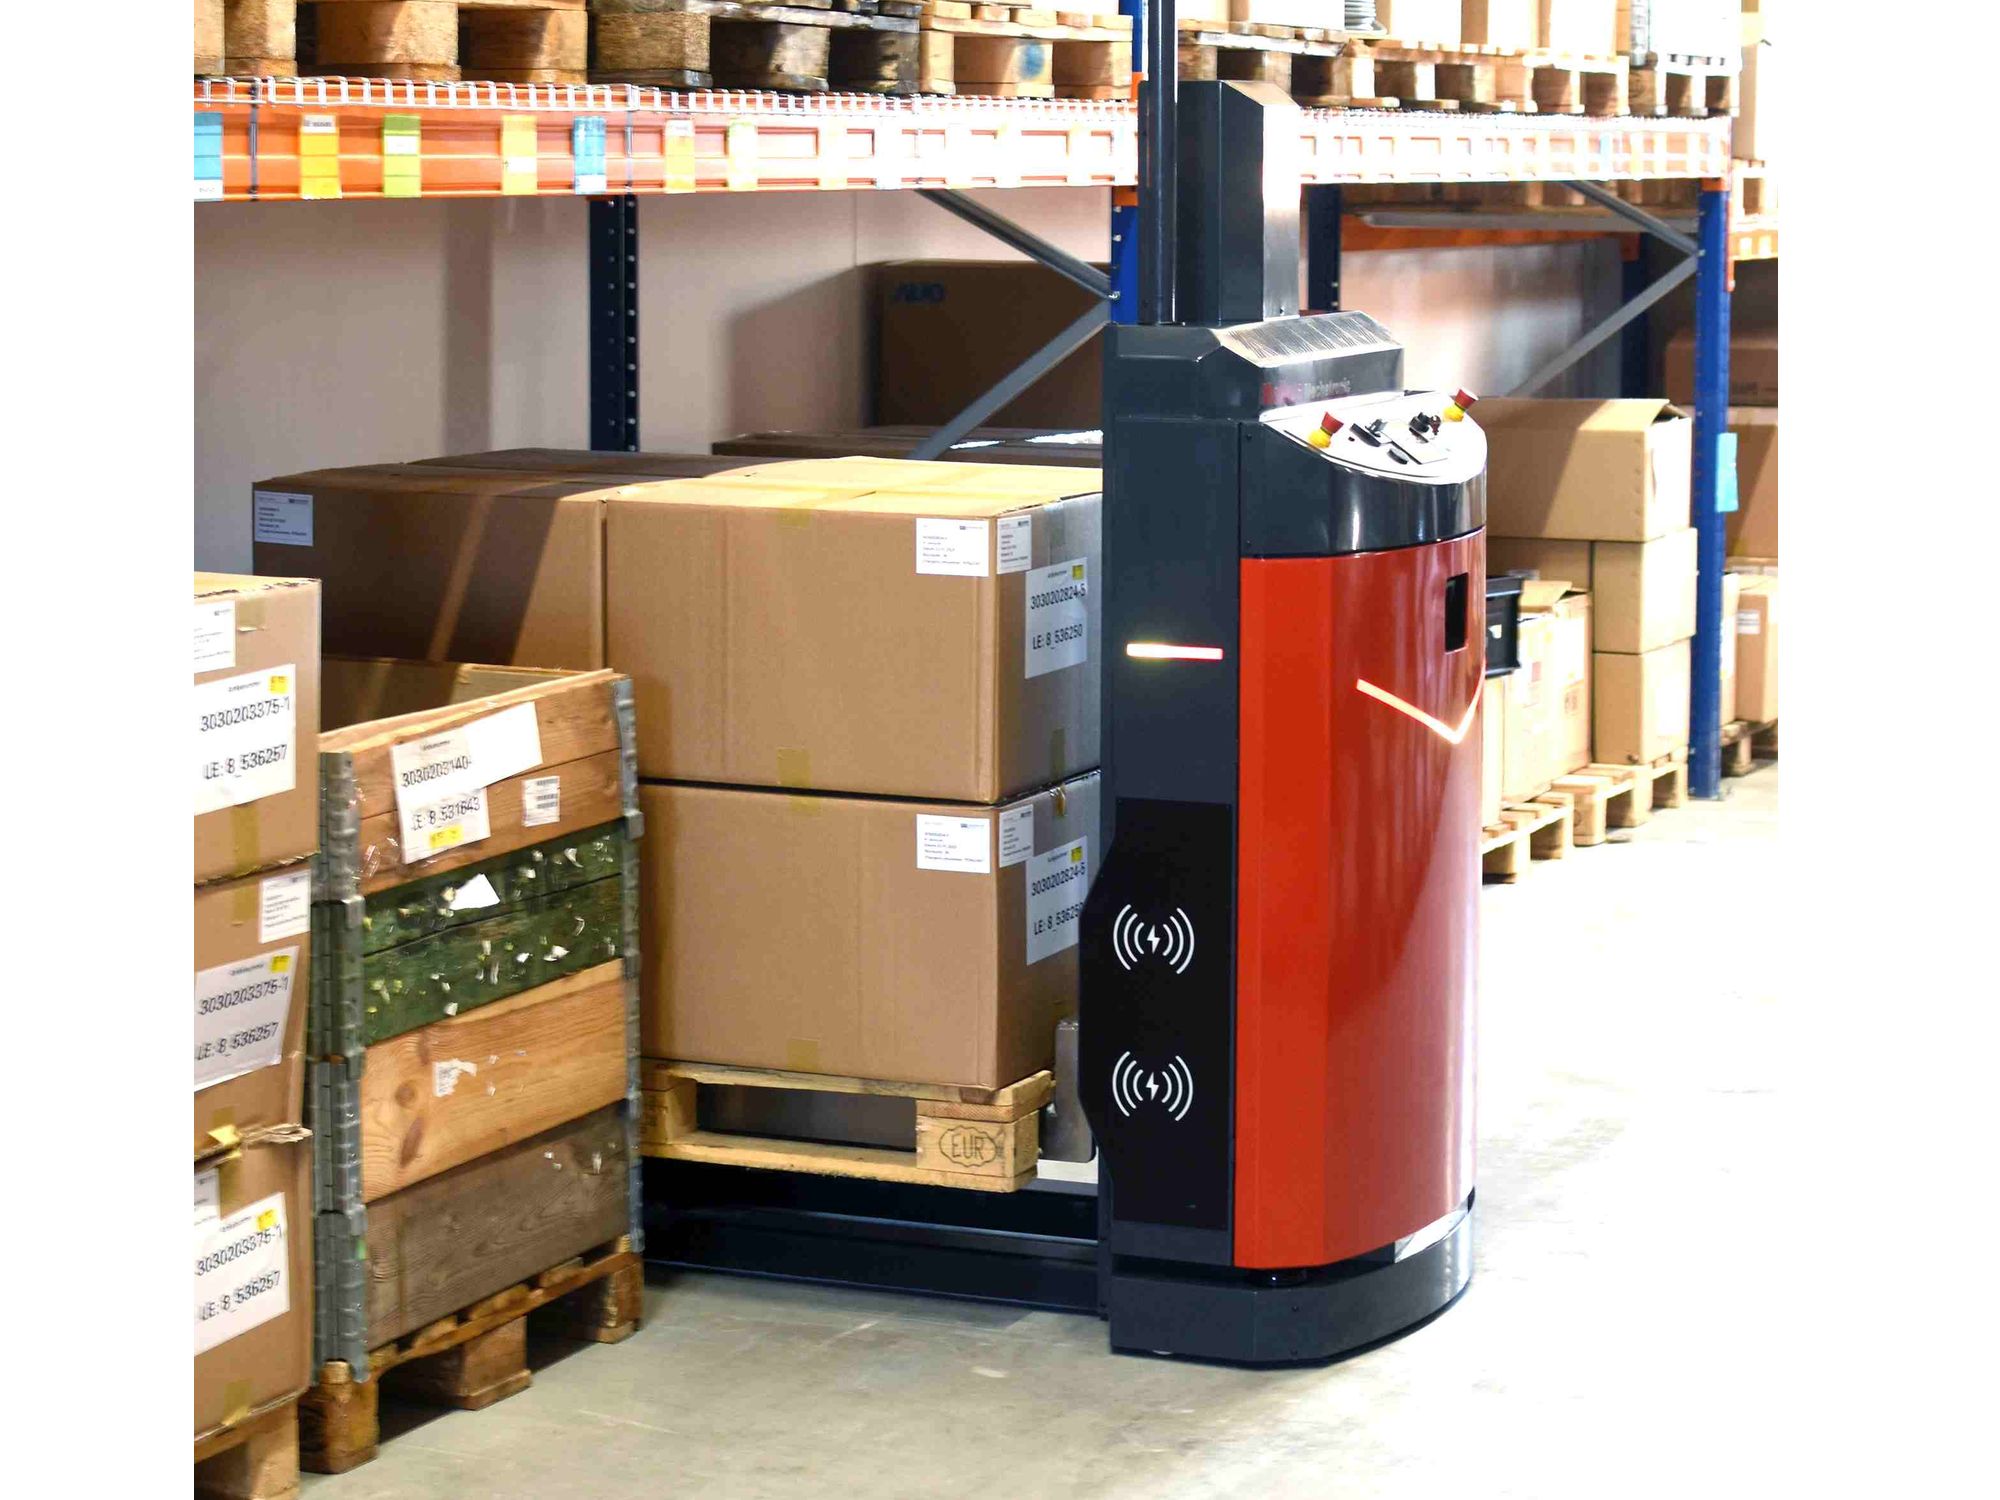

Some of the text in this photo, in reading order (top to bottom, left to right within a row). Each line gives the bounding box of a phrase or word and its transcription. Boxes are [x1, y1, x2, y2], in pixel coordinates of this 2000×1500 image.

[1030, 583, 1086, 610] 3030202824-5
[200, 696, 290, 732] 3030203375-1
[198, 976, 289, 1016] 3030203375-1
[951, 1133, 985, 1161] EUR
[195, 1224, 283, 1277] 3030203375-1
